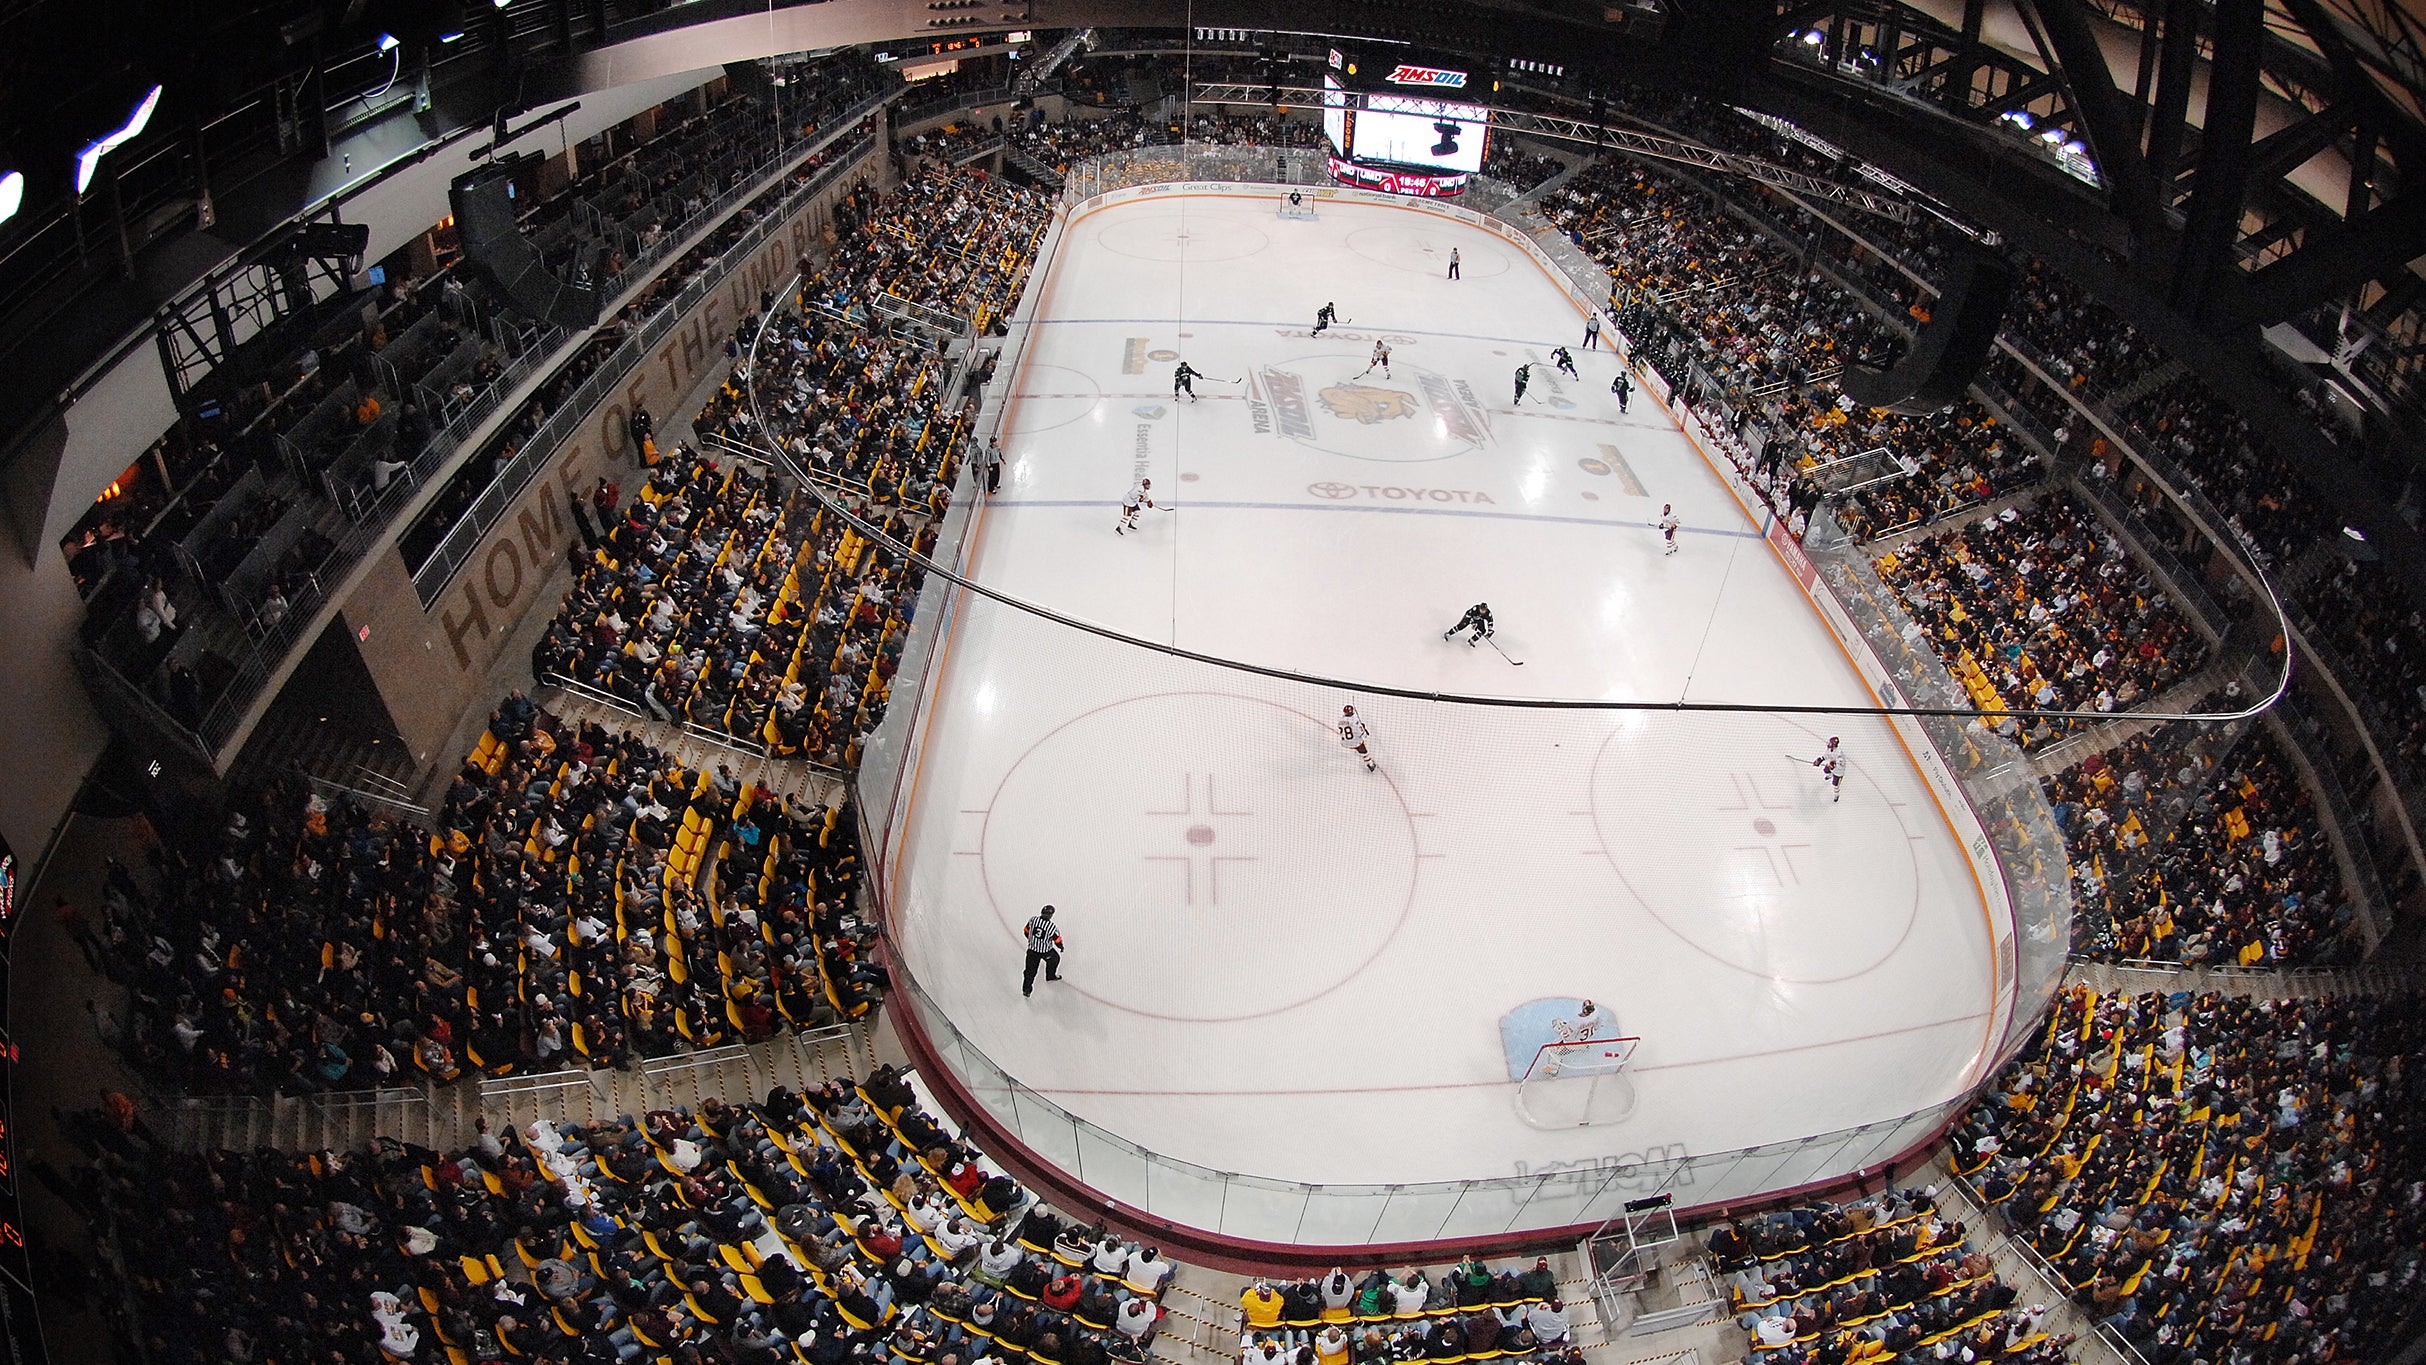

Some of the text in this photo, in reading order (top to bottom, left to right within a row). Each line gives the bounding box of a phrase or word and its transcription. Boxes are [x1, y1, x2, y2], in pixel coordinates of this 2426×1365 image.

[1389, 66, 1466, 87] AMSOIL
[1360, 169, 1382, 182] UMD
[1138, 185, 1171, 195] AMSOIL
[1182, 183, 1232, 193] Great Clips
[1384, 183, 1391, 192] 0
[1261, 367, 1314, 440] AMSOIL
[1453, 378, 1479, 410] ARENA
[1249, 401, 1271, 434] ARENA
[1134, 422, 1152, 460] Essentia
[441, 449, 596, 671] HOME
[601, 373, 647, 461] OF
[659, 298, 729, 393] THE
[731, 238, 786, 316] UMD
[1359, 485, 1496, 505] TOYOTA
[1786, 539, 1807, 572] YAMAHA
[1579, 1027, 1597, 1042] 31
